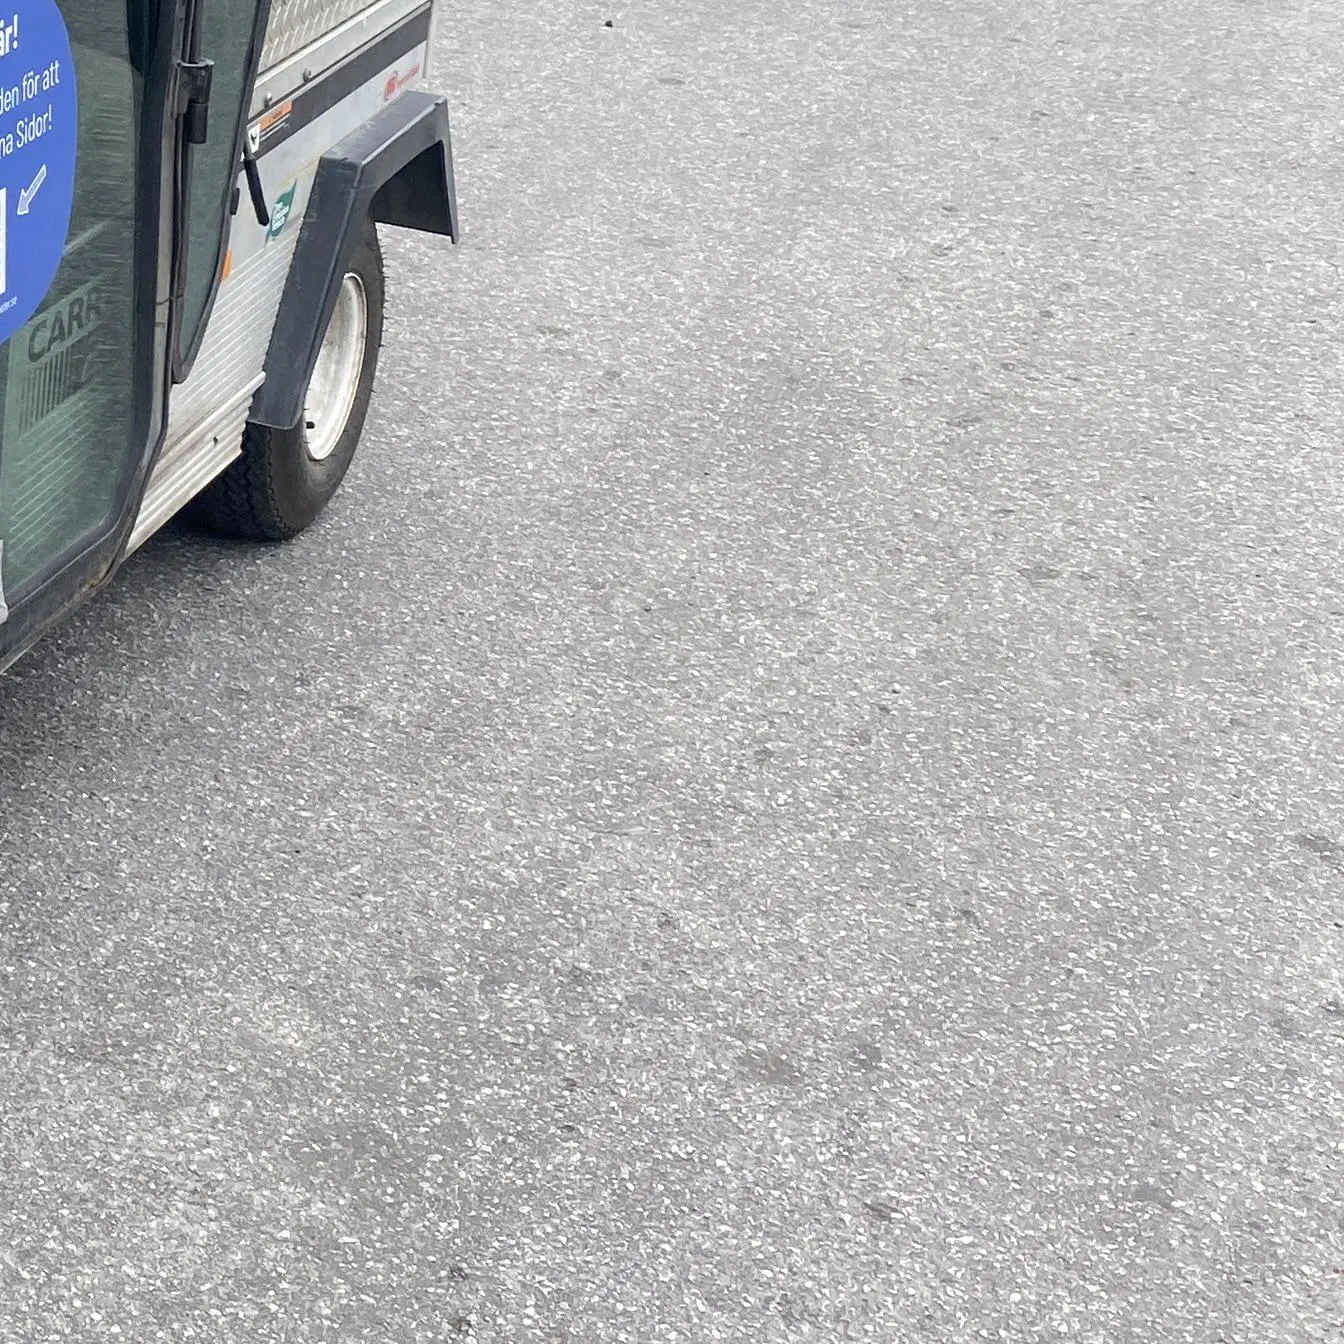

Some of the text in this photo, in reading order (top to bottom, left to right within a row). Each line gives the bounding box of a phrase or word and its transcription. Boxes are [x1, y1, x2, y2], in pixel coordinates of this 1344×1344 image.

[21, 69, 41, 102] för
[42, 59, 61, 91] att
[16, 103, 53, 149] Sidor!
